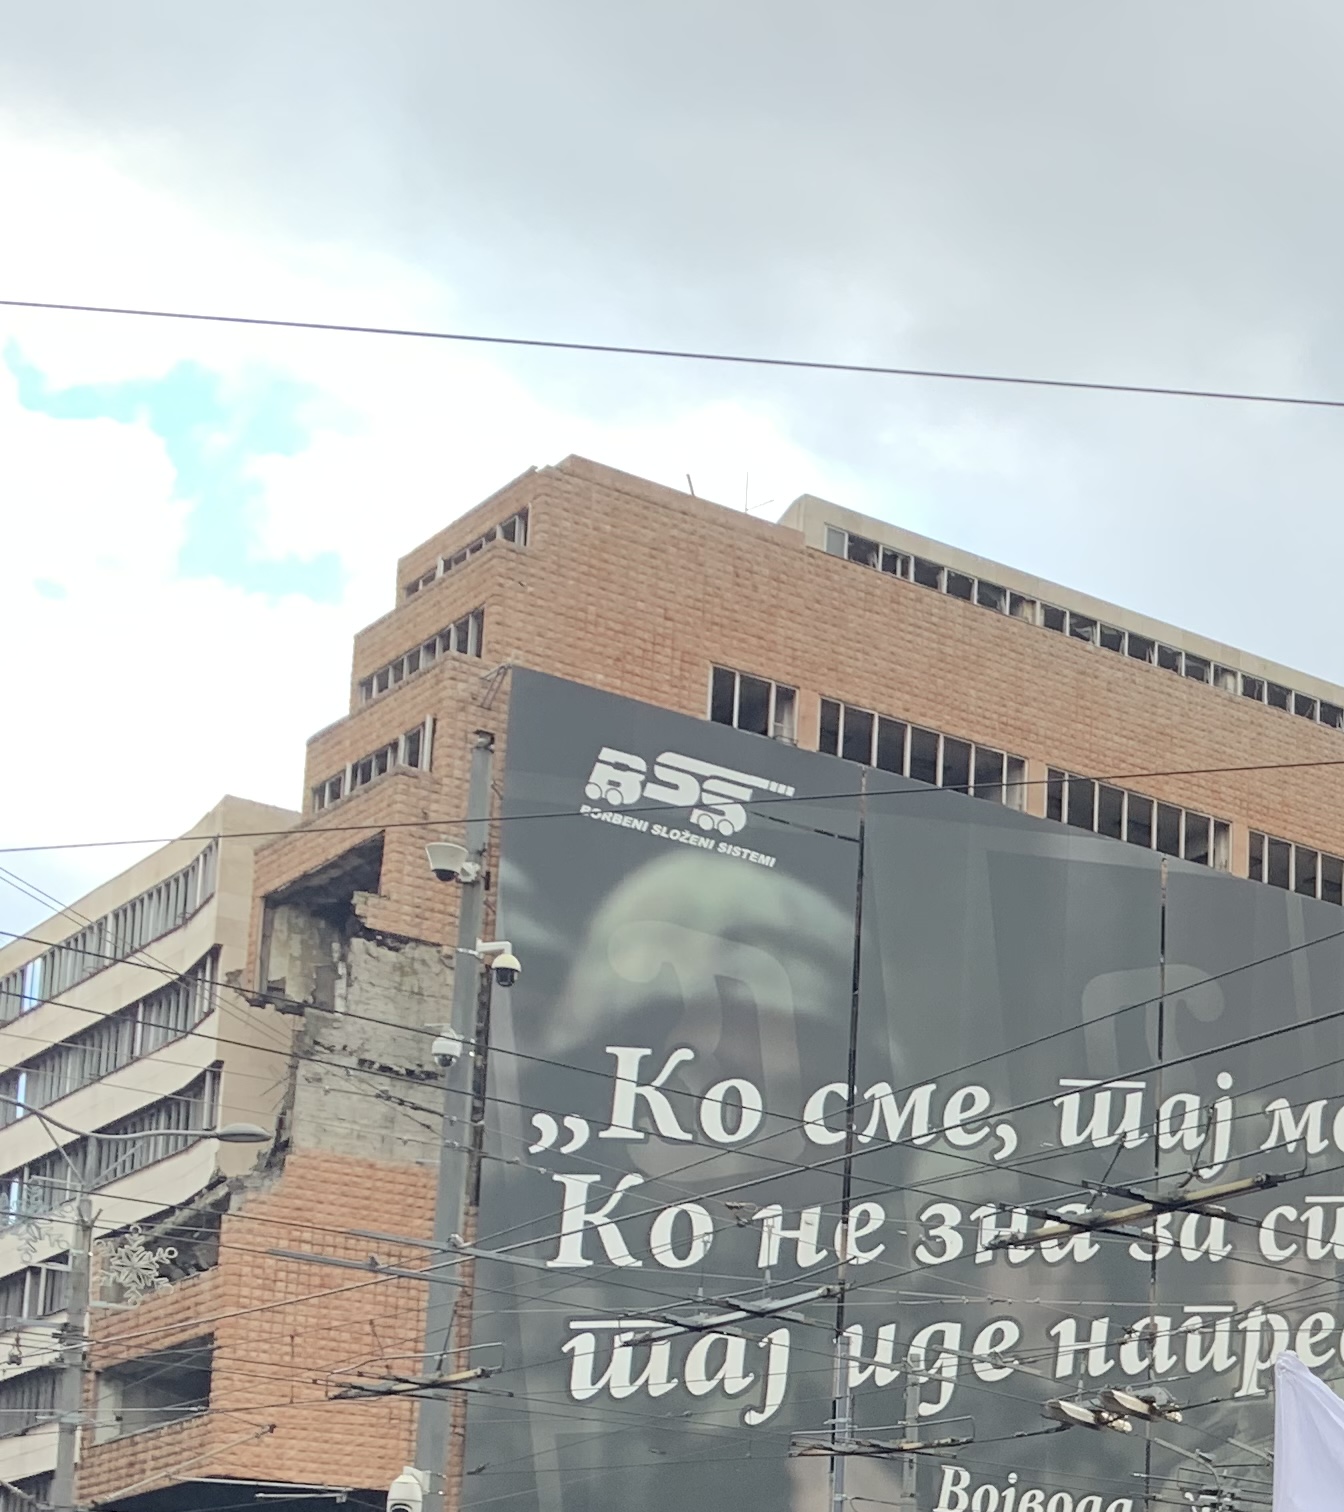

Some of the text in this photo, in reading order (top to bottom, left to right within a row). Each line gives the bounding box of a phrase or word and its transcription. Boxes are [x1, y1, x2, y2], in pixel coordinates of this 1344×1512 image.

[650, 823, 716, 851] SLOŽENI
[717, 842, 777, 868] SISTEMI
[803, 1080, 1018, 1161] сме,
[546, 1172, 715, 1269] Ко
[752, 1201, 886, 1269] не
[842, 1318, 1021, 1417] иде
